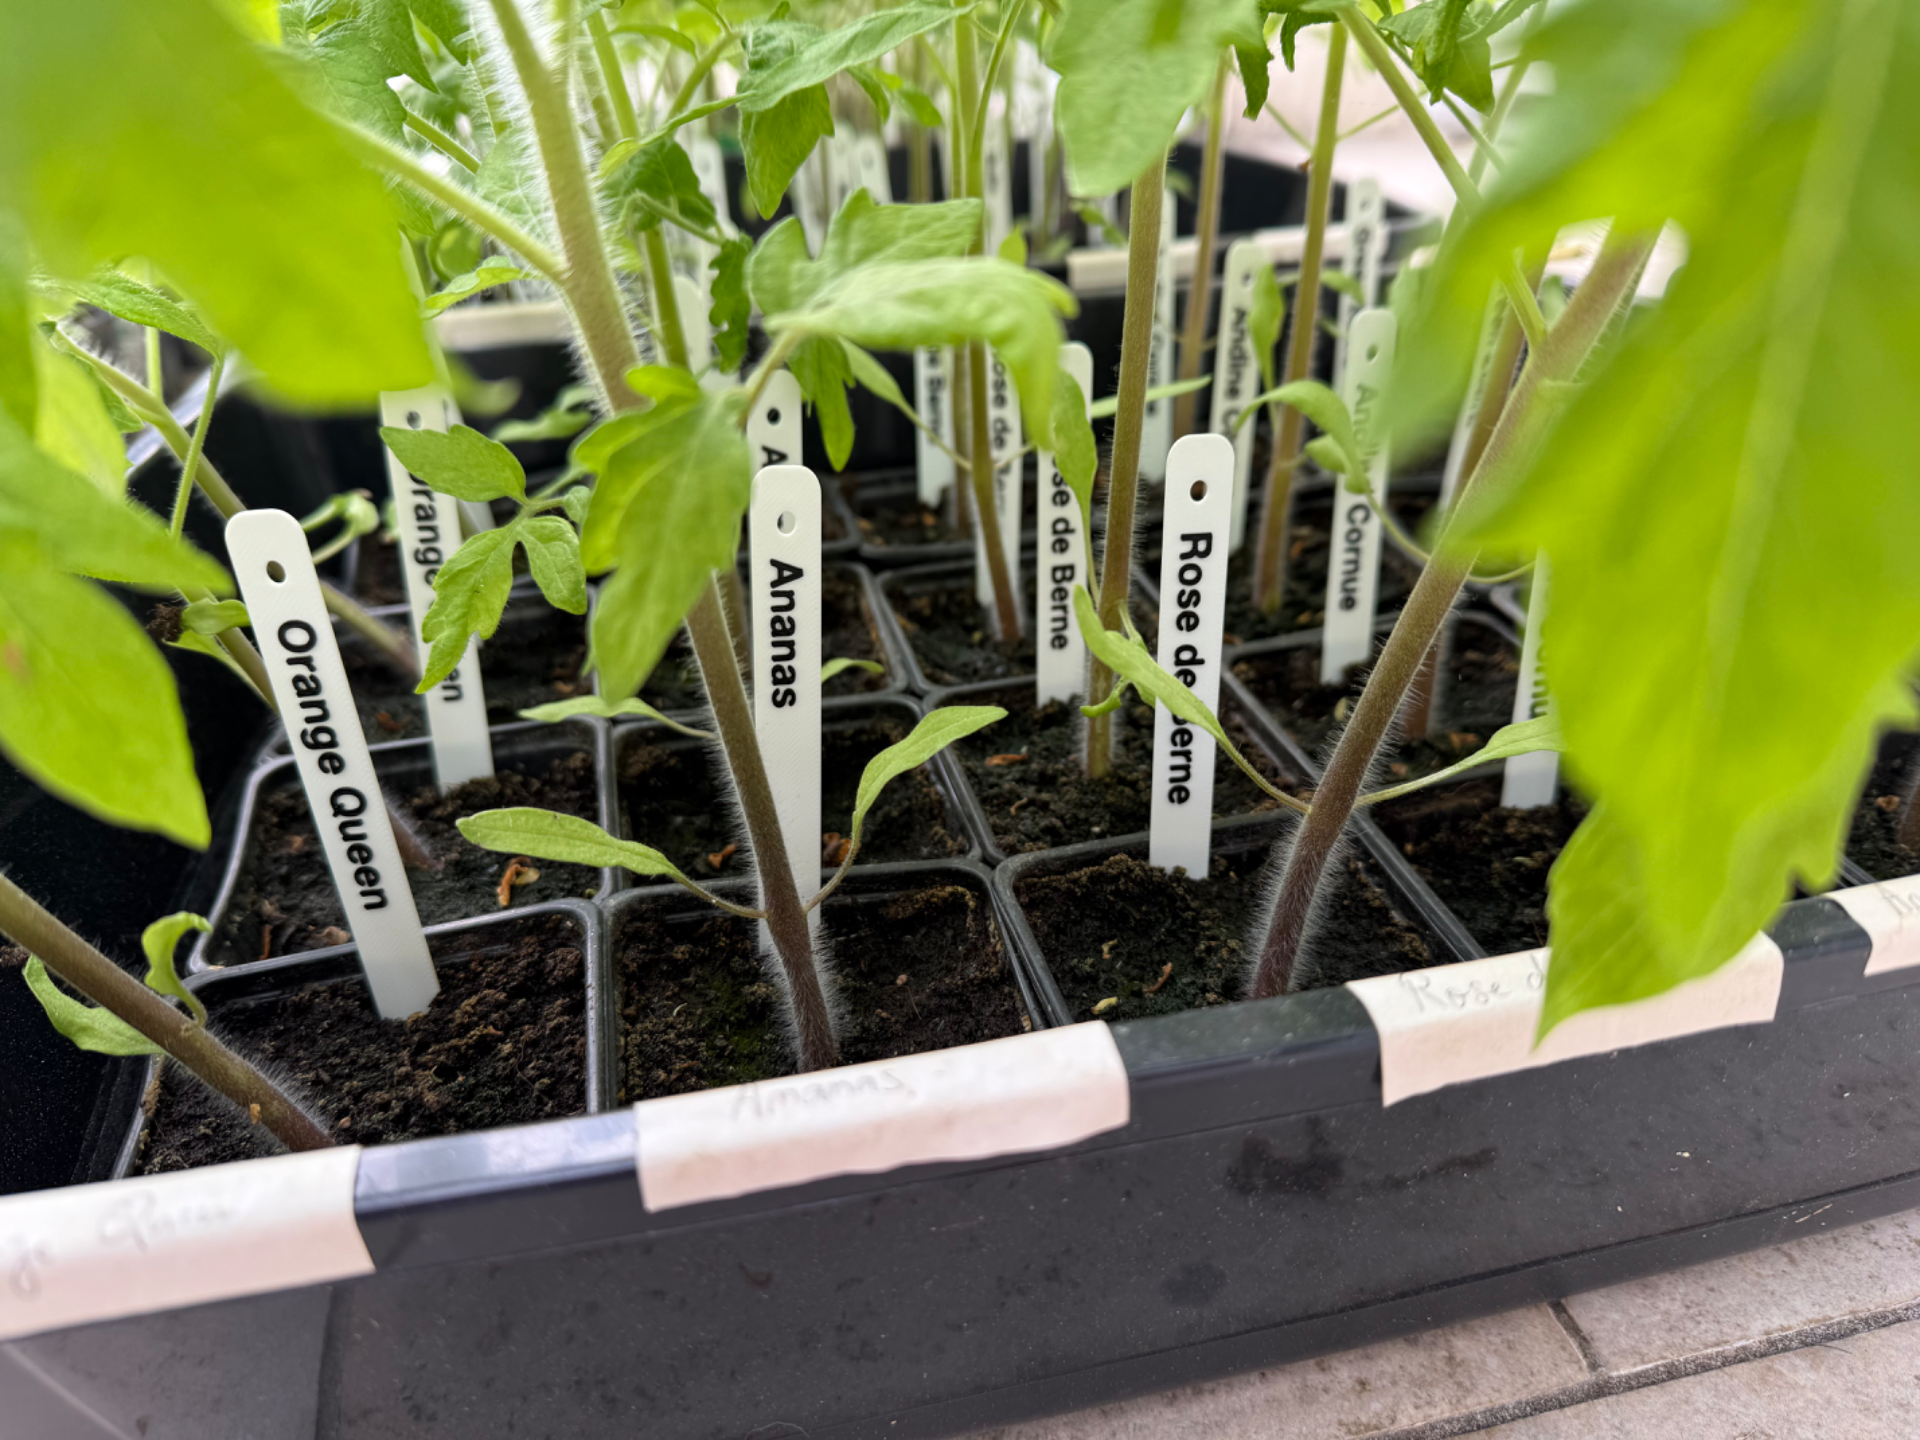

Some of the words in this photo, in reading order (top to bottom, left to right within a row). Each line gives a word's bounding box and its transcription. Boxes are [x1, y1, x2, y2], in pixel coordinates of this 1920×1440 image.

[991, 348, 1008, 408] ose
[1223, 307, 1249, 399] Andine
[1051, 516, 1075, 554] de
[1338, 503, 1371, 612] Cornue
[1051, 564, 1075, 650] Berne
[1176, 532, 1213, 633] Rose
[769, 558, 804, 709] Ananas
[277, 619, 346, 776] Orange
[329, 786, 389, 911] Queen
[1168, 714, 1194, 805] erne
